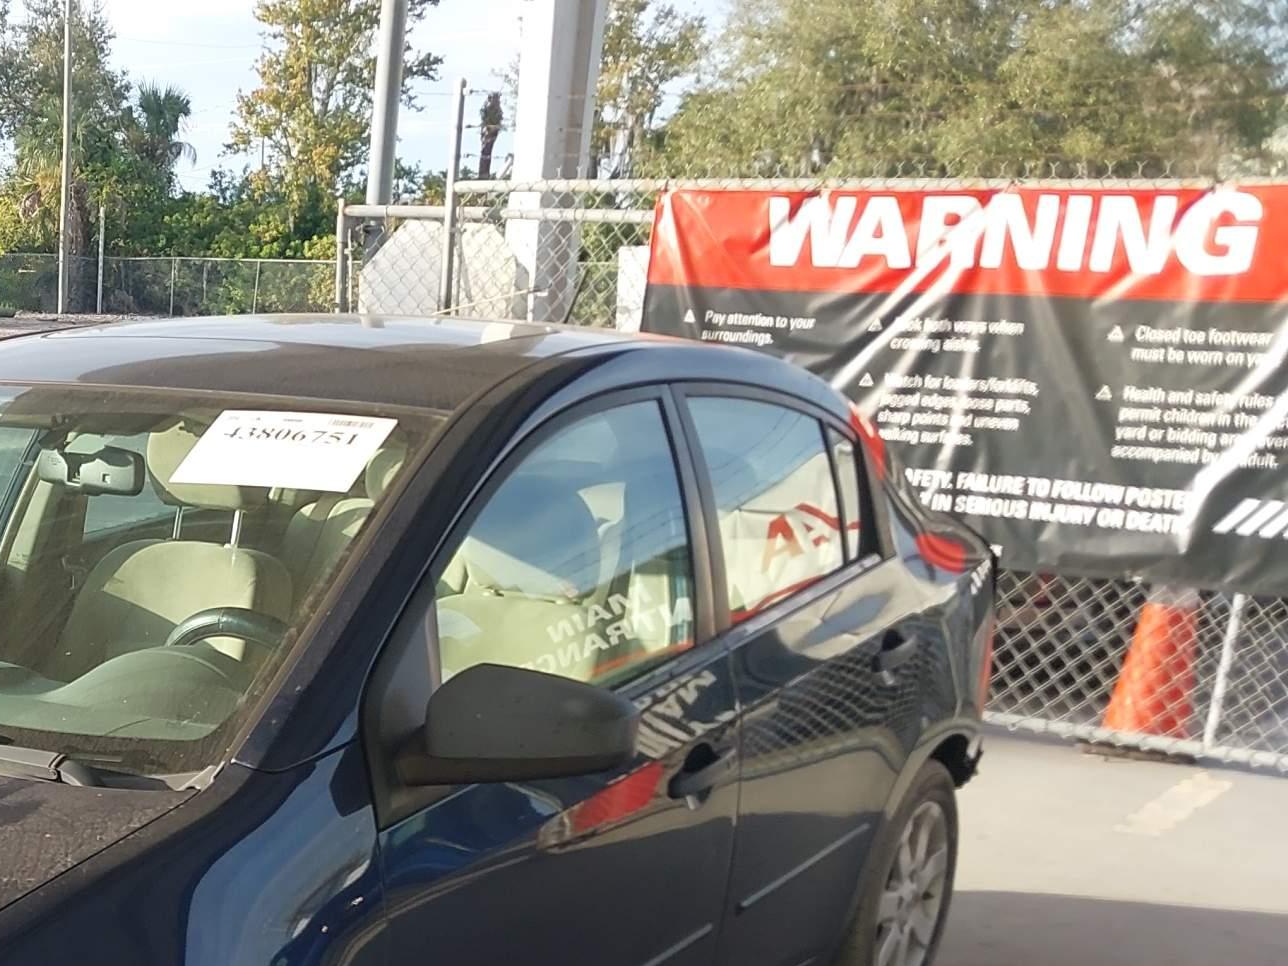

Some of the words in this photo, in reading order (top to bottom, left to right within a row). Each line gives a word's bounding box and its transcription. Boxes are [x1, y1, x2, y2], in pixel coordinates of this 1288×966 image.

[769, 190, 1263, 273] WARNING
[704, 310, 726, 326] Pay
[727, 312, 773, 328] attention
[775, 315, 788, 328] to
[790, 318, 816, 331] your
[701, 329, 774, 346] surroundings.
[1135, 325, 1181, 343] Closed
[1183, 328, 1207, 344] toe
[1208, 328, 1275, 347] footwear
[1130, 347, 1165, 363] must
[1167, 346, 1185, 363] be
[1187, 350, 1223, 366] worn
[1225, 353, 1245, 367] on
[1123, 385, 1166, 403] Health
[1167, 389, 1194, 406] and
[1238, 393, 1275, 409] rules
[1118, 406, 1162, 424] permit
[224, 426, 359, 445] 43806751
[1115, 425, 1147, 441] yard
[1149, 428, 1165, 442] or
[1167, 427, 1217, 448] bidding
[1111, 446, 1200, 464] accompanied
[956, 471, 1026, 495] FAILURE
[1027, 476, 1051, 498] TO
[1051, 478, 1125, 506] FOLLOW
[930, 492, 953, 512] IN
[954, 495, 1029, 518] SERIOUS
[1097, 506, 1125, 529] OR
